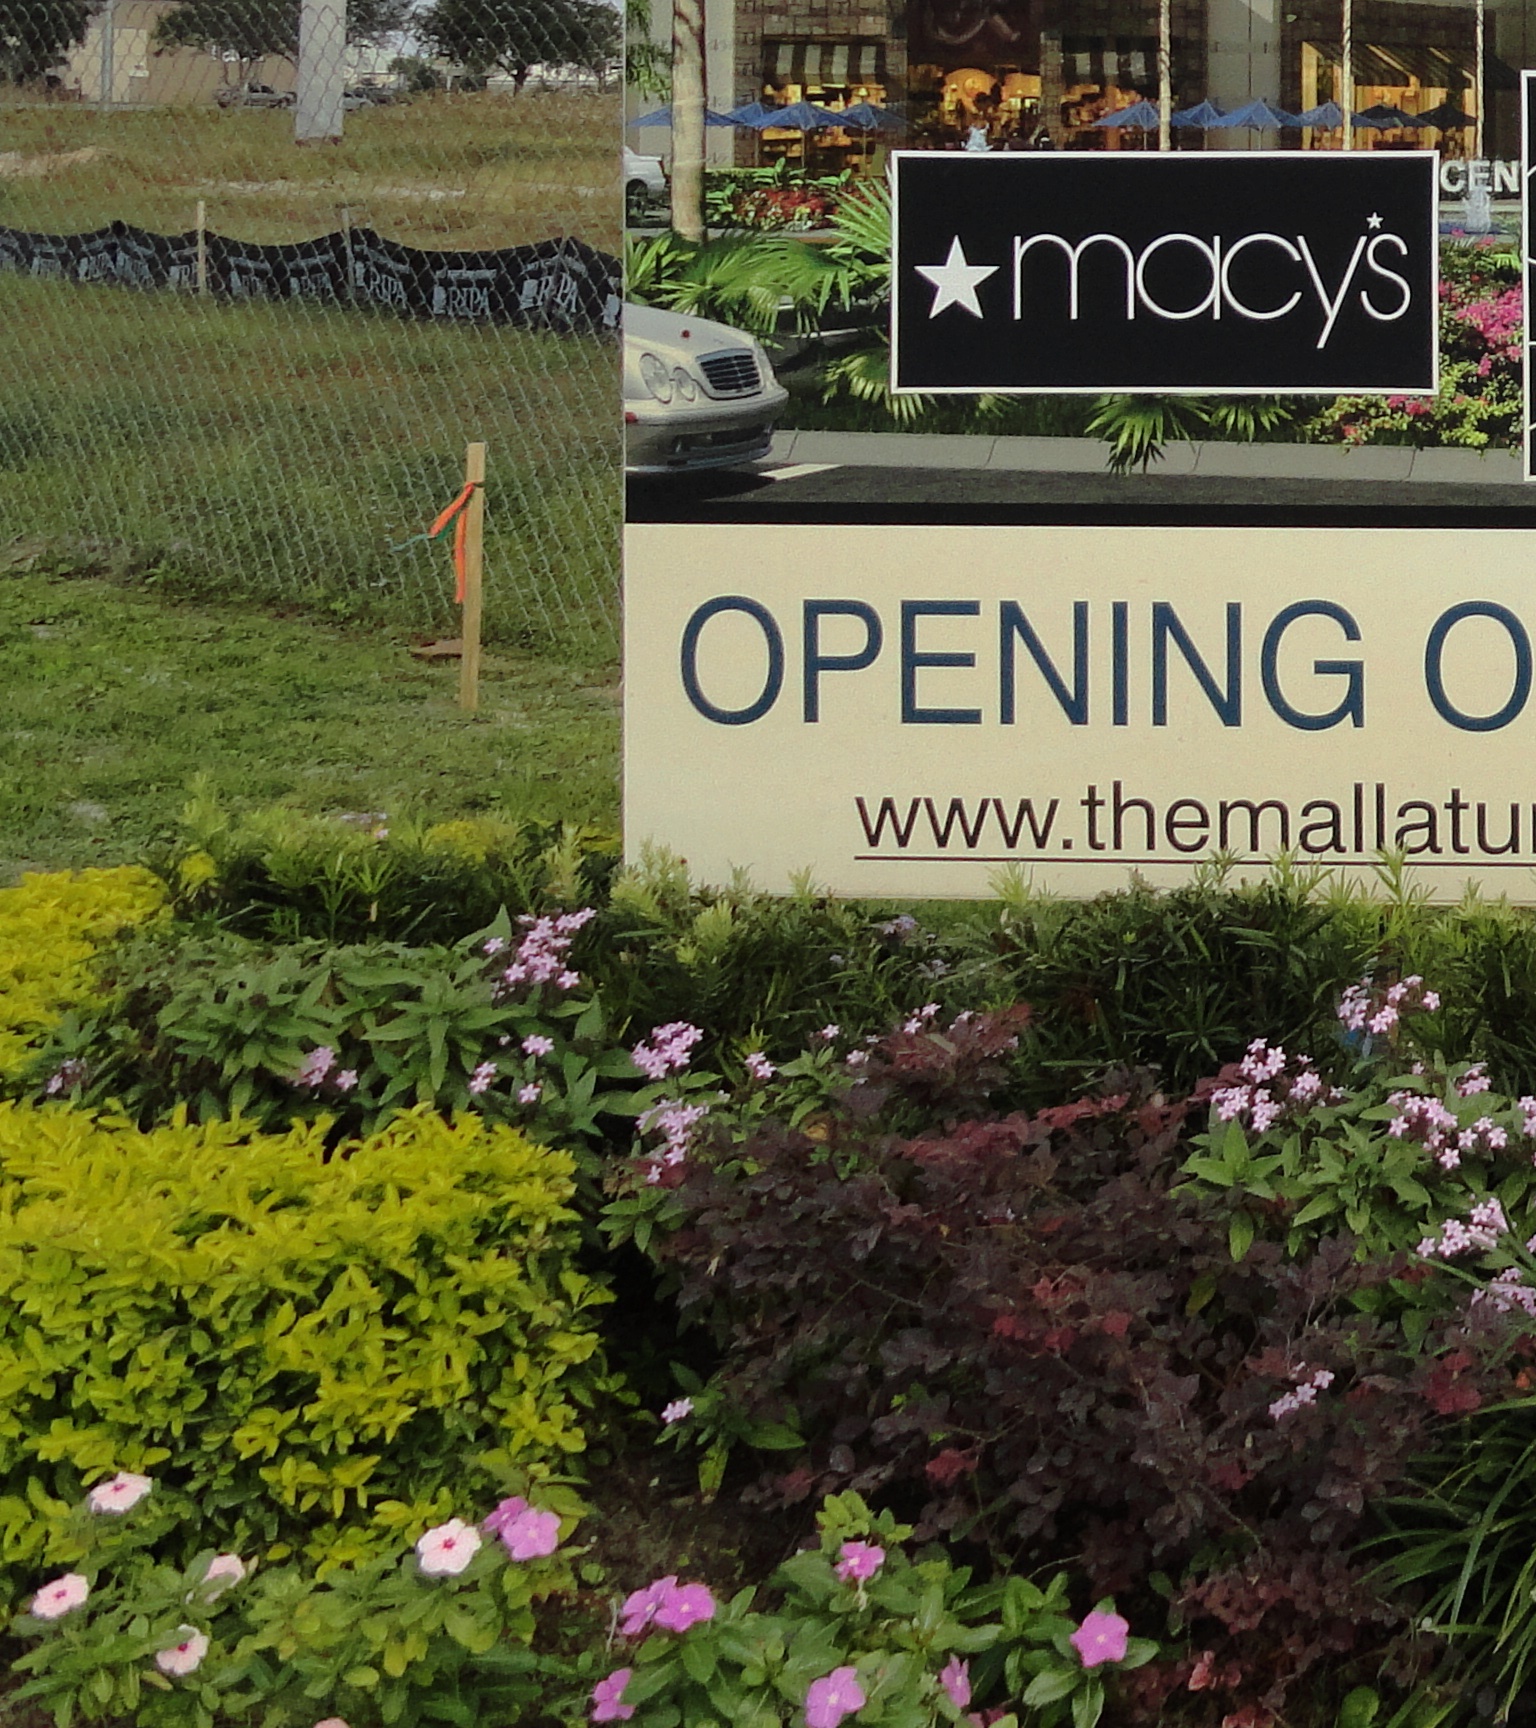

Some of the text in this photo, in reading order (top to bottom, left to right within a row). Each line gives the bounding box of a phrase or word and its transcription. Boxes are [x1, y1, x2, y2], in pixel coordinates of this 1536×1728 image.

[1440, 159, 1520, 193] CEN
[537, 273, 578, 314] RPA
[1013, 212, 1411, 349] macy's
[680, 595, 1365, 732] OPENING
